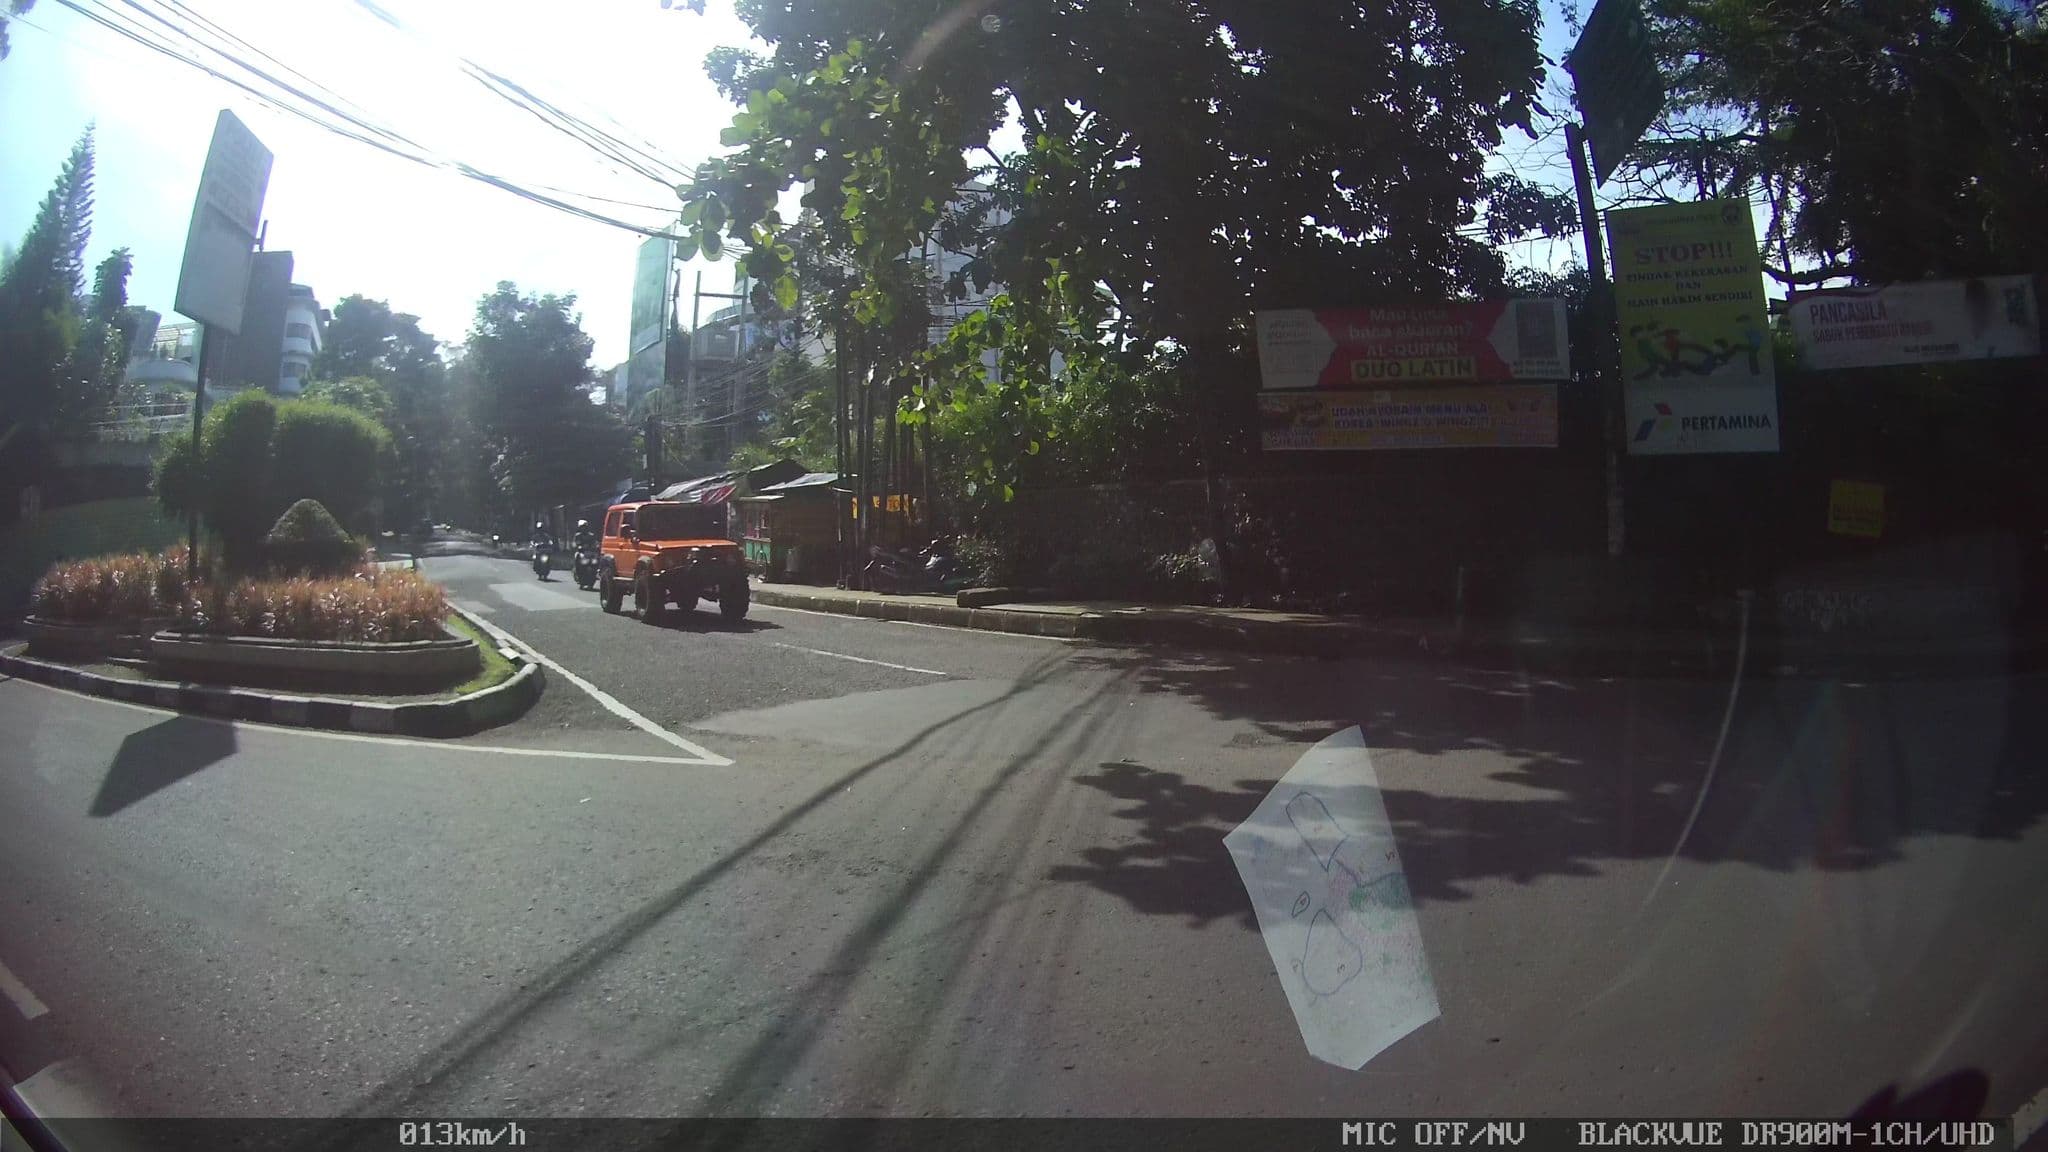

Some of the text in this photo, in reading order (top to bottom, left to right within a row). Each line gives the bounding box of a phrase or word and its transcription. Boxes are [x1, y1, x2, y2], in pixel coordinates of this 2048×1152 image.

[1634, 240, 1734, 265] STOP!!!
[1676, 281, 1701, 291] DAN
[1809, 299, 1889, 325] PANCASILA
[1355, 357, 1474, 378] DUO LATIN
[1681, 414, 1772, 432] PERTAMINA
